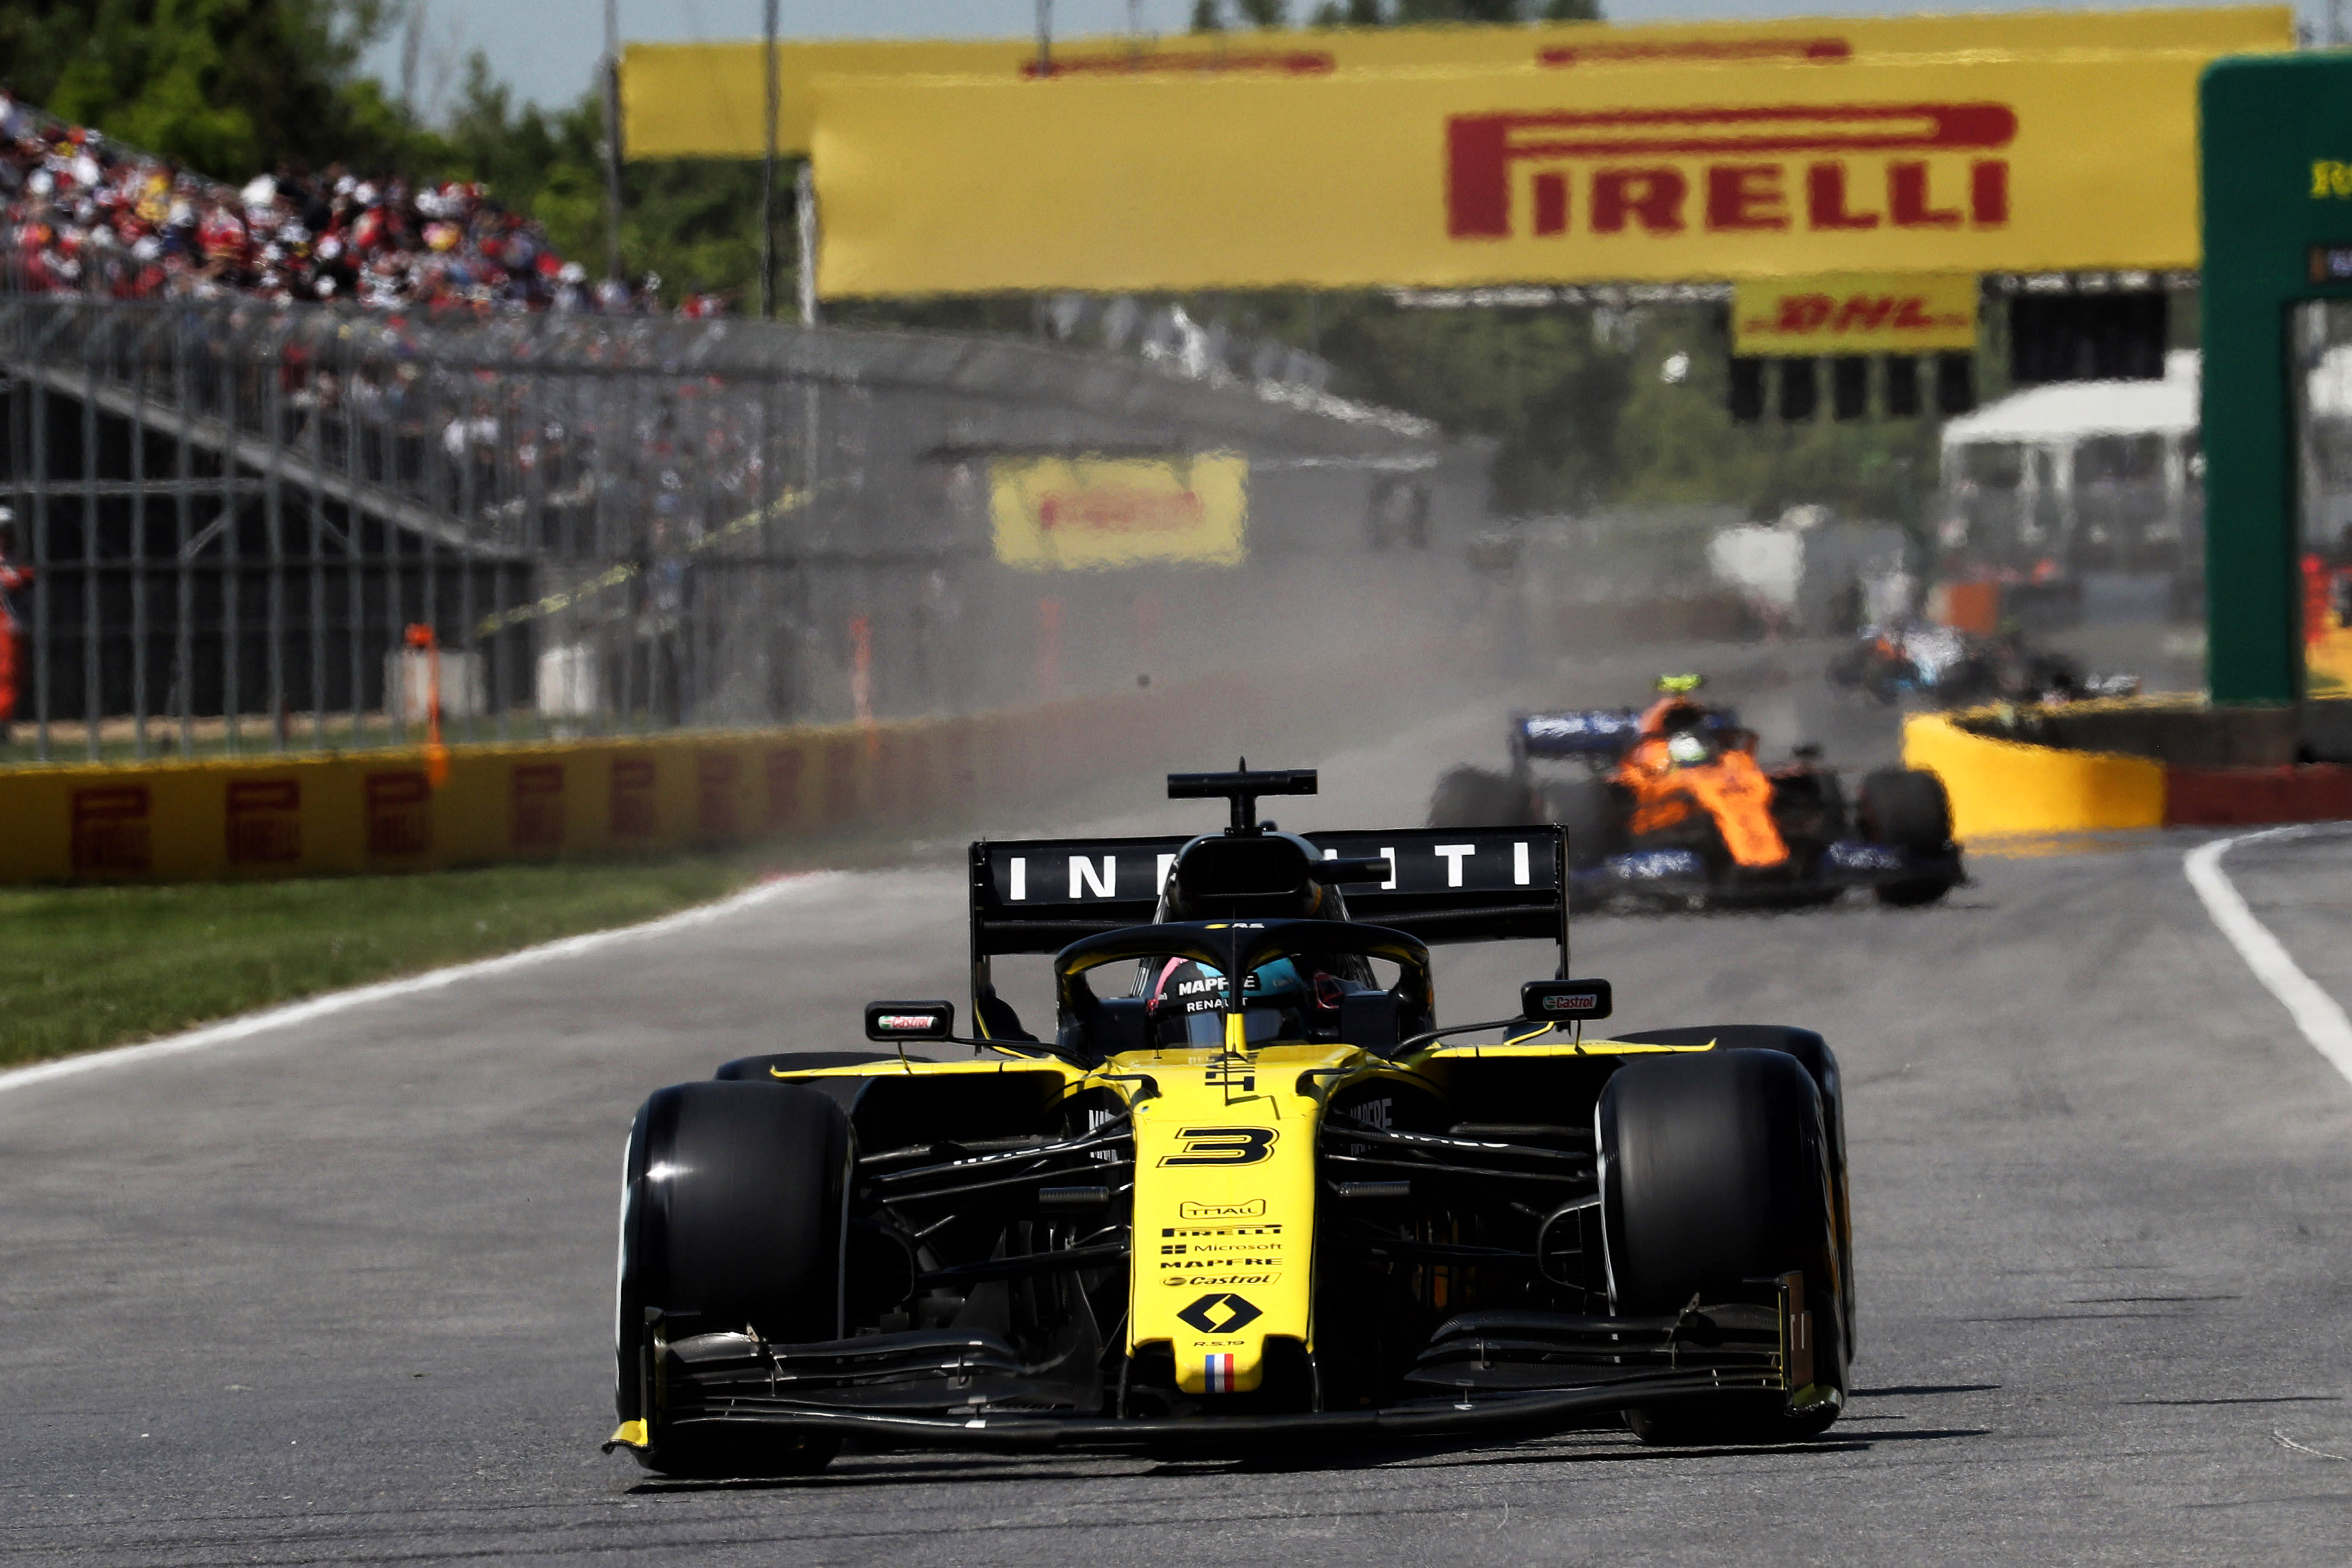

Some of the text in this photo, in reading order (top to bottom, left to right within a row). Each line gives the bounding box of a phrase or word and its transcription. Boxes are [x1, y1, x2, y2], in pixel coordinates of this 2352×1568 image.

[1444, 101, 2019, 241] PIRELLI
[1774, 293, 1933, 335] DHL
[1179, 975, 1256, 996] MAPFE
[1556, 996, 1594, 1008] Castrol
[893, 1016, 929, 1028] Castrol
[1156, 1126, 1280, 1167] 3
[1161, 1224, 1283, 1238] PIRELLI
[1194, 1243, 1283, 1251] Microsoft
[1160, 1258, 1283, 1269] MAPFRE
[1189, 1275, 1270, 1285] Castrol
